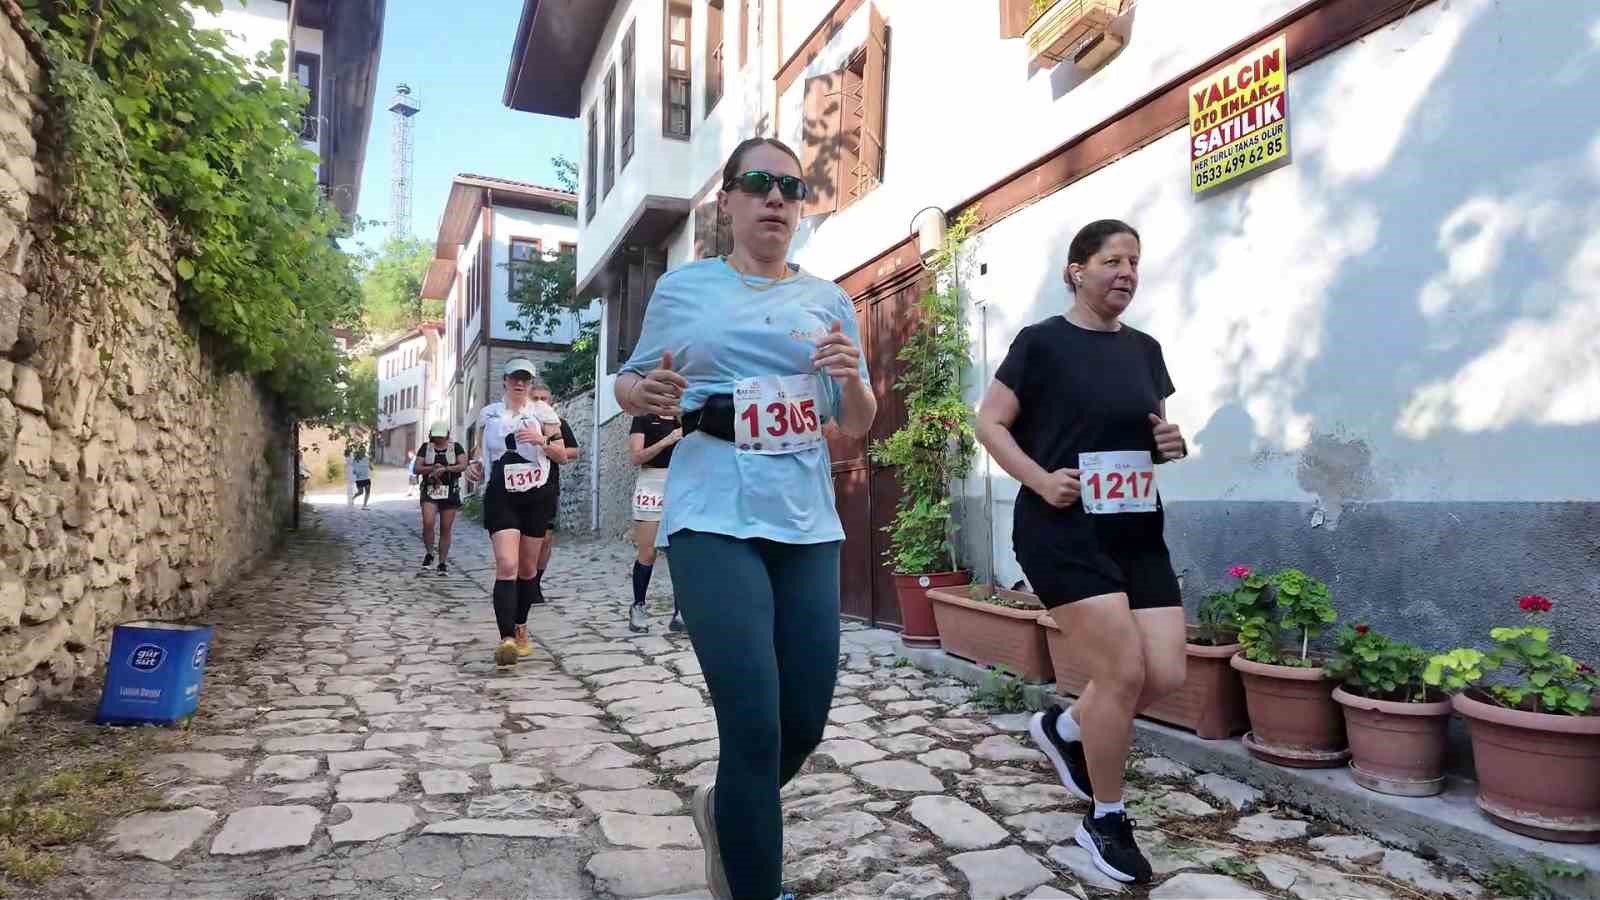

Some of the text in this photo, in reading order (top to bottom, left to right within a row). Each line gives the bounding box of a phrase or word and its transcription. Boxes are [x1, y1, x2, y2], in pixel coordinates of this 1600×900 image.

[1193, 109, 1218, 132] OTO
[1193, 96, 1283, 157] SATILIK
[1194, 159, 1208, 172] HER
[1234, 137, 1260, 153] TAKAS
[1261, 124, 1284, 140] OLUR
[1196, 138, 1282, 187] 0533 499 62 85
[741, 399, 817, 438] 1305
[507, 469, 541, 487] 1312
[1087, 471, 1153, 500] 1217
[636, 494, 664, 506] 1212
